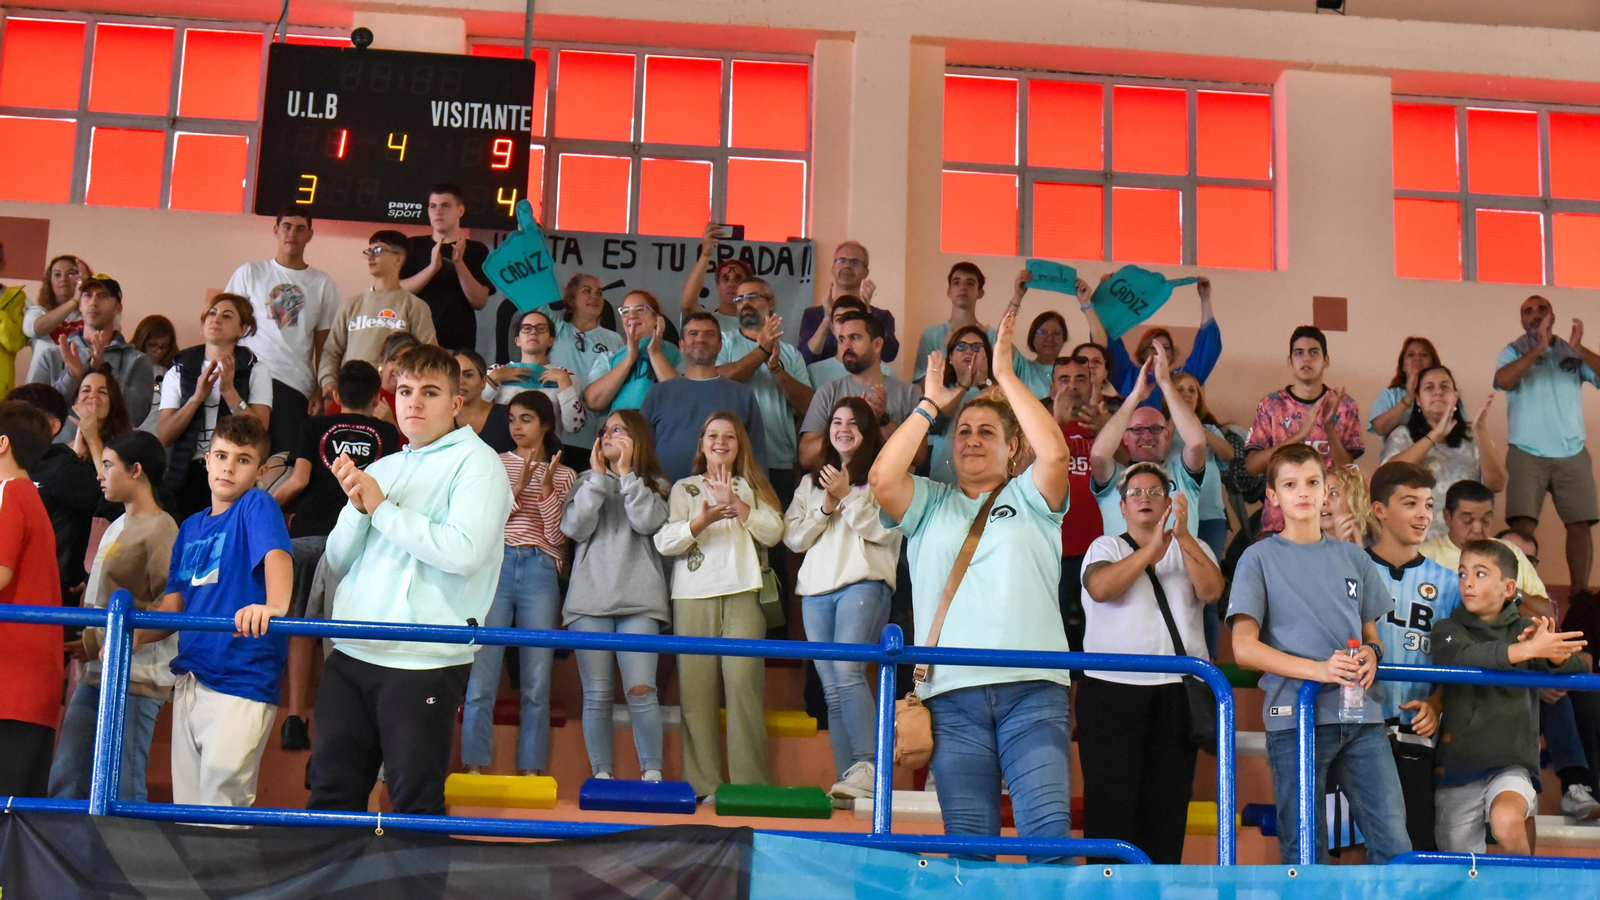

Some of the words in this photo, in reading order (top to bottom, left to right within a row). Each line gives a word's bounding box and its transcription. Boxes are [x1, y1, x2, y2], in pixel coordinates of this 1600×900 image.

[287, 90, 338, 120] U.L.B
[431, 100, 532, 132] VISITANTE
[338, 129, 347, 158] 1
[387, 132, 408, 162] 4
[491, 138, 513, 169] 9
[296, 174, 318, 204] 3
[497, 187, 518, 217] 4
[387, 209, 422, 219] sport
[388, 201, 423, 210] payre
[602, 238, 638, 270] ES
[651, 242, 686, 272] TU
[348, 315, 407, 332] ellesse
[332, 440, 372, 457] VANS
[1403, 630, 1432, 655] 30
